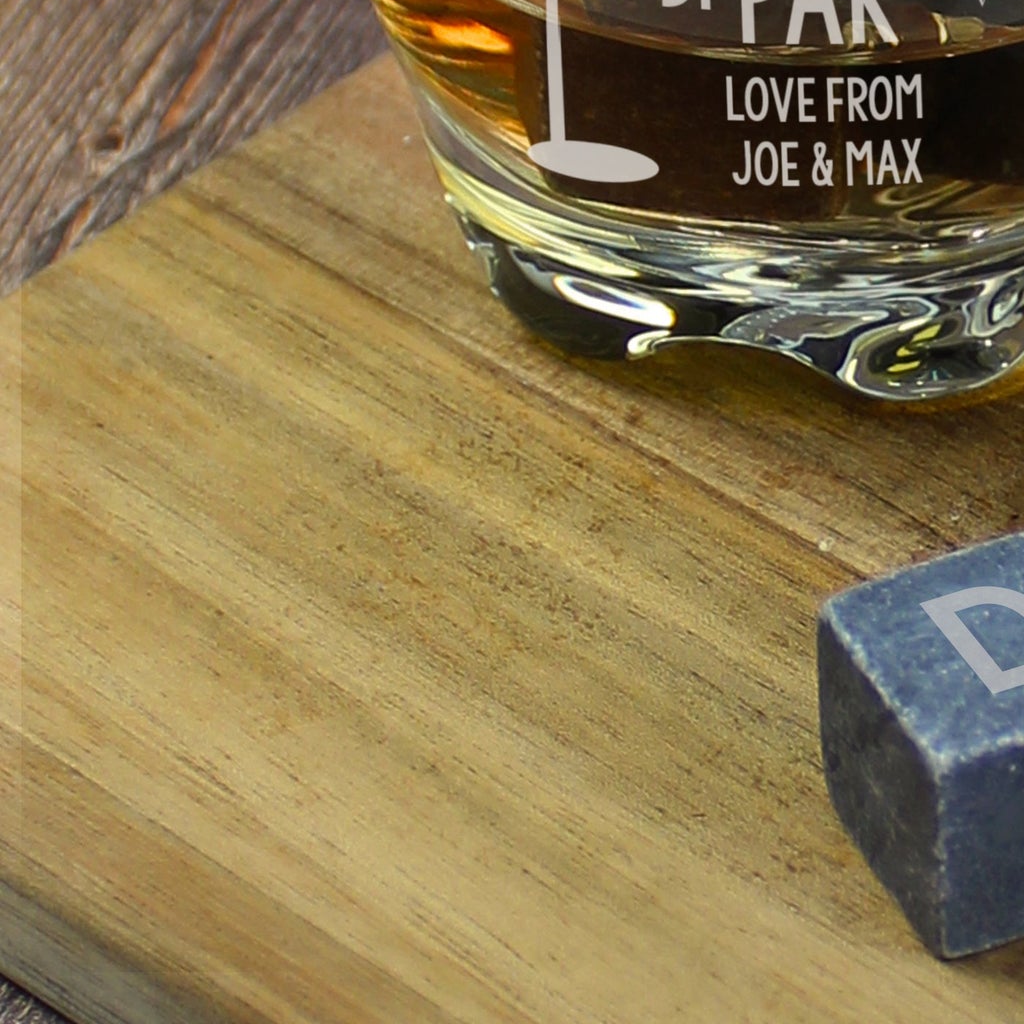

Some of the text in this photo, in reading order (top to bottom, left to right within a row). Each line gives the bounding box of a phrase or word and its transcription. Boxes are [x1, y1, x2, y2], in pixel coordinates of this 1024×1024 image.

[726, 74, 924, 123] LOVE FROM
[732, 138, 924, 186] JOE & MAX
